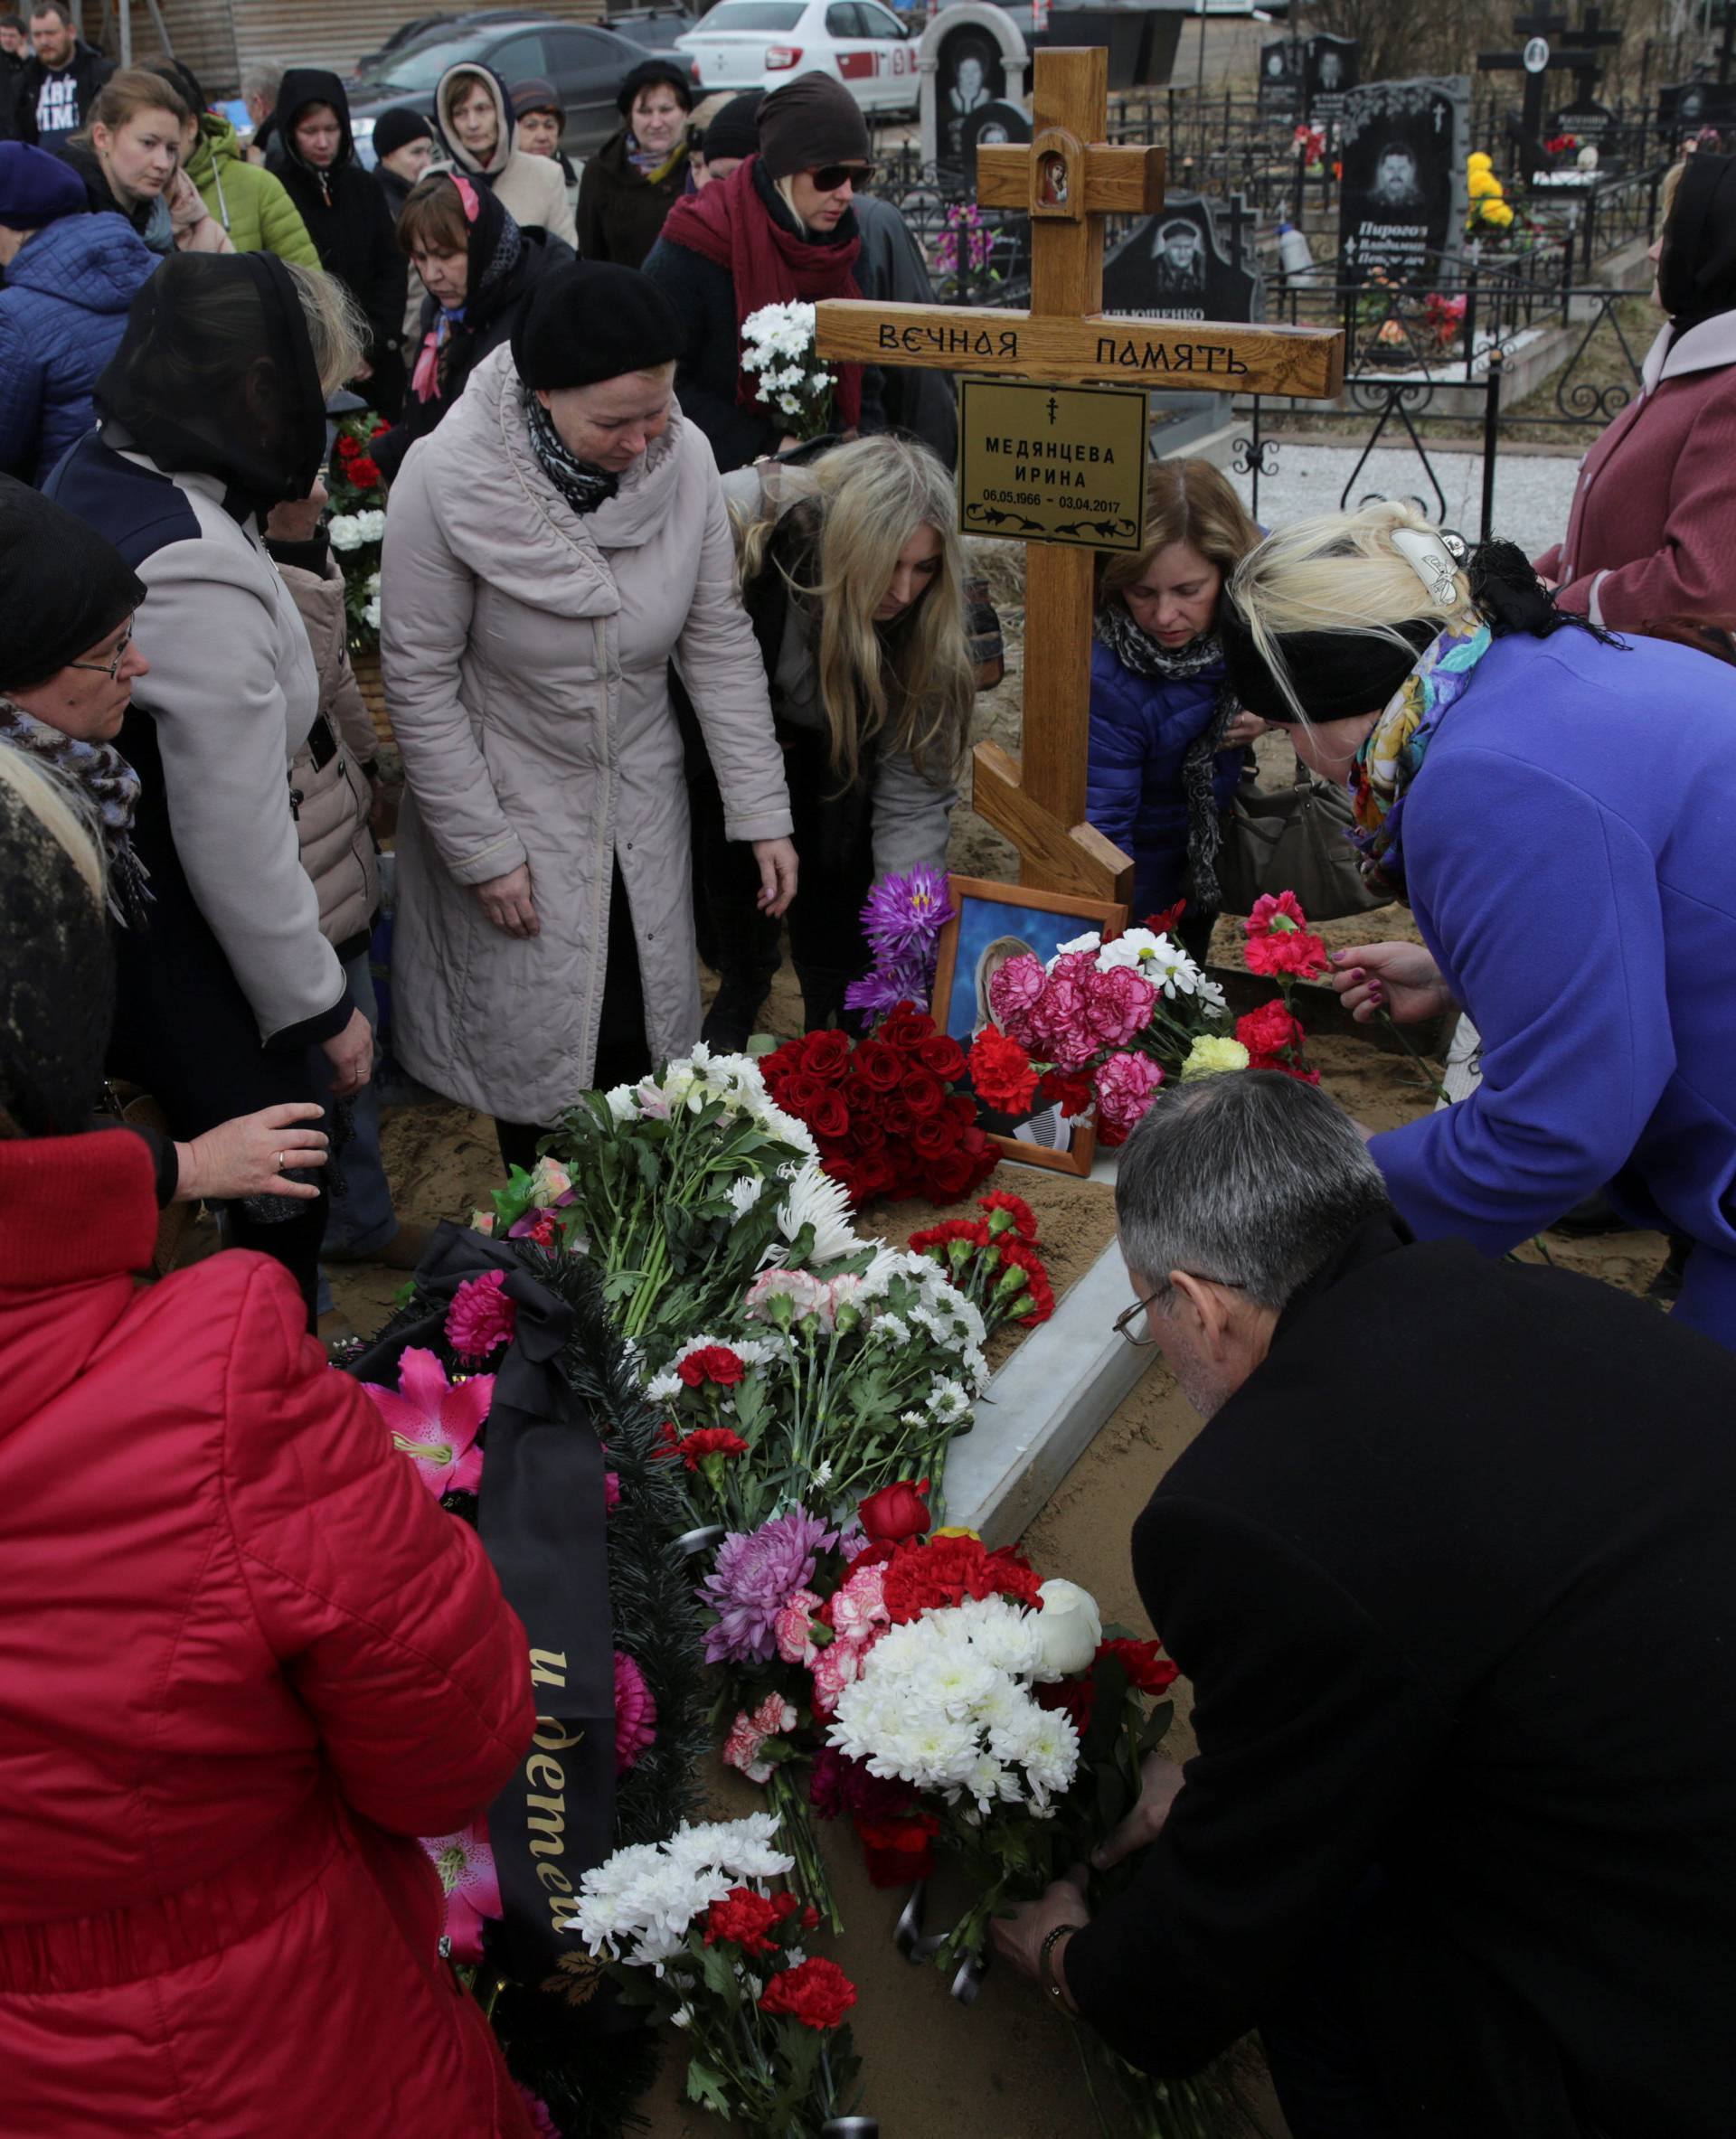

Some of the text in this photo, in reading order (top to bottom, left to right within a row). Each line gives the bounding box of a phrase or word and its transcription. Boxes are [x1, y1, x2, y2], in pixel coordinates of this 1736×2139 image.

[1097, 338, 1249, 374] ПАМЯТЬ
[986, 437, 1115, 464] МЕДЯНЦЕВА
[1015, 465, 1086, 488] ИРИНА
[983, 489, 1042, 506] 06.05.1966
[1059, 496, 1121, 514] 03.04.2017
